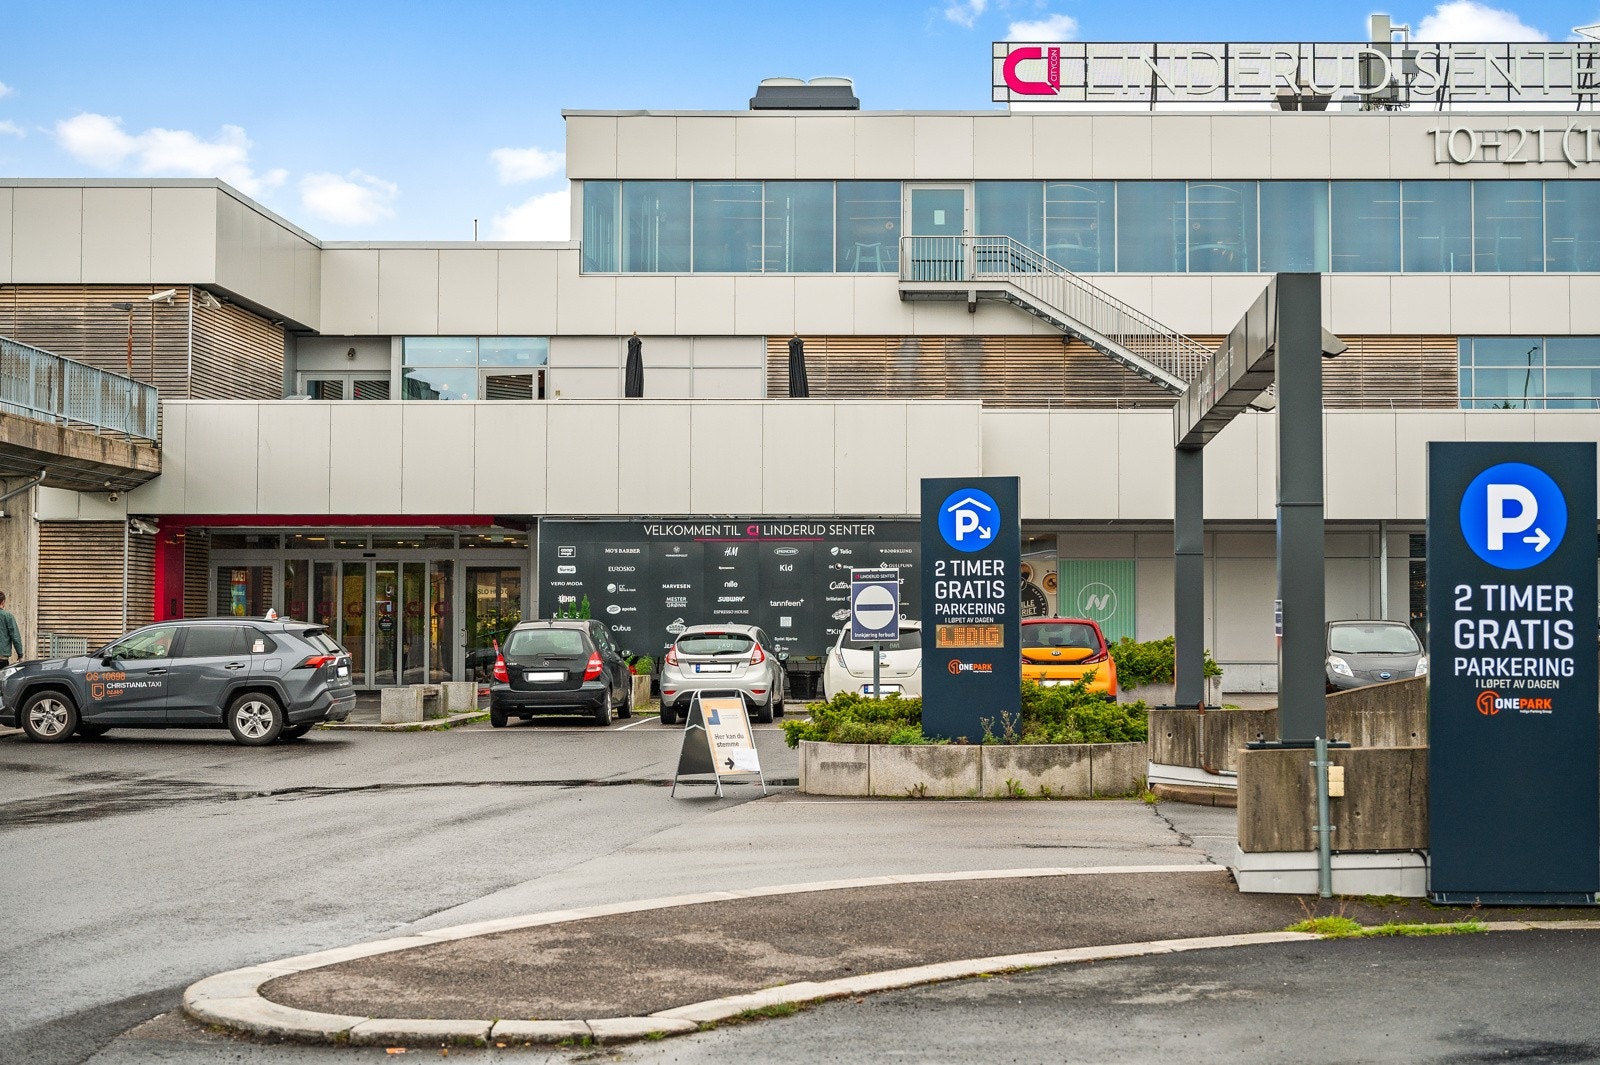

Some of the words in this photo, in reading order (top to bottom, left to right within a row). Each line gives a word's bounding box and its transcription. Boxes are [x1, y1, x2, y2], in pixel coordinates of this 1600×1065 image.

[1050, 50, 1058, 81] CITYCON
[1086, 48, 1392, 96] LINDERUD
[1413, 48, 1599, 96] SENTE
[1427, 125, 1545, 165] 10-21
[1562, 120, 1600, 168] (1
[955, 510, 979, 541] P
[1487, 484, 1538, 551] P
[643, 524, 721, 536] VELKOMMEN
[723, 524, 741, 536] TIL
[763, 524, 826, 536] LINDERUD
[829, 524, 875, 536] SENTER
[935, 560, 946, 577] 2
[950, 559, 1005, 576] TIMER
[935, 580, 1005, 599] GRATIS
[1454, 584, 1473, 611] 2
[1480, 584, 1574, 612] TIMER
[935, 603, 1005, 615] PARKERING
[942, 628, 998, 646] LEDIG
[1454, 619, 1574, 650] GRATIS
[86, 672, 99, 681] OS
[1454, 657, 1574, 677] PARKERING
[1476, 679, 1478, 688] I
[1481, 678, 1511, 688] LØPET
[1513, 679, 1525, 688] AV
[1528, 680, 1559, 688] DAGEN
[1495, 698, 1552, 710] ONEPARK
